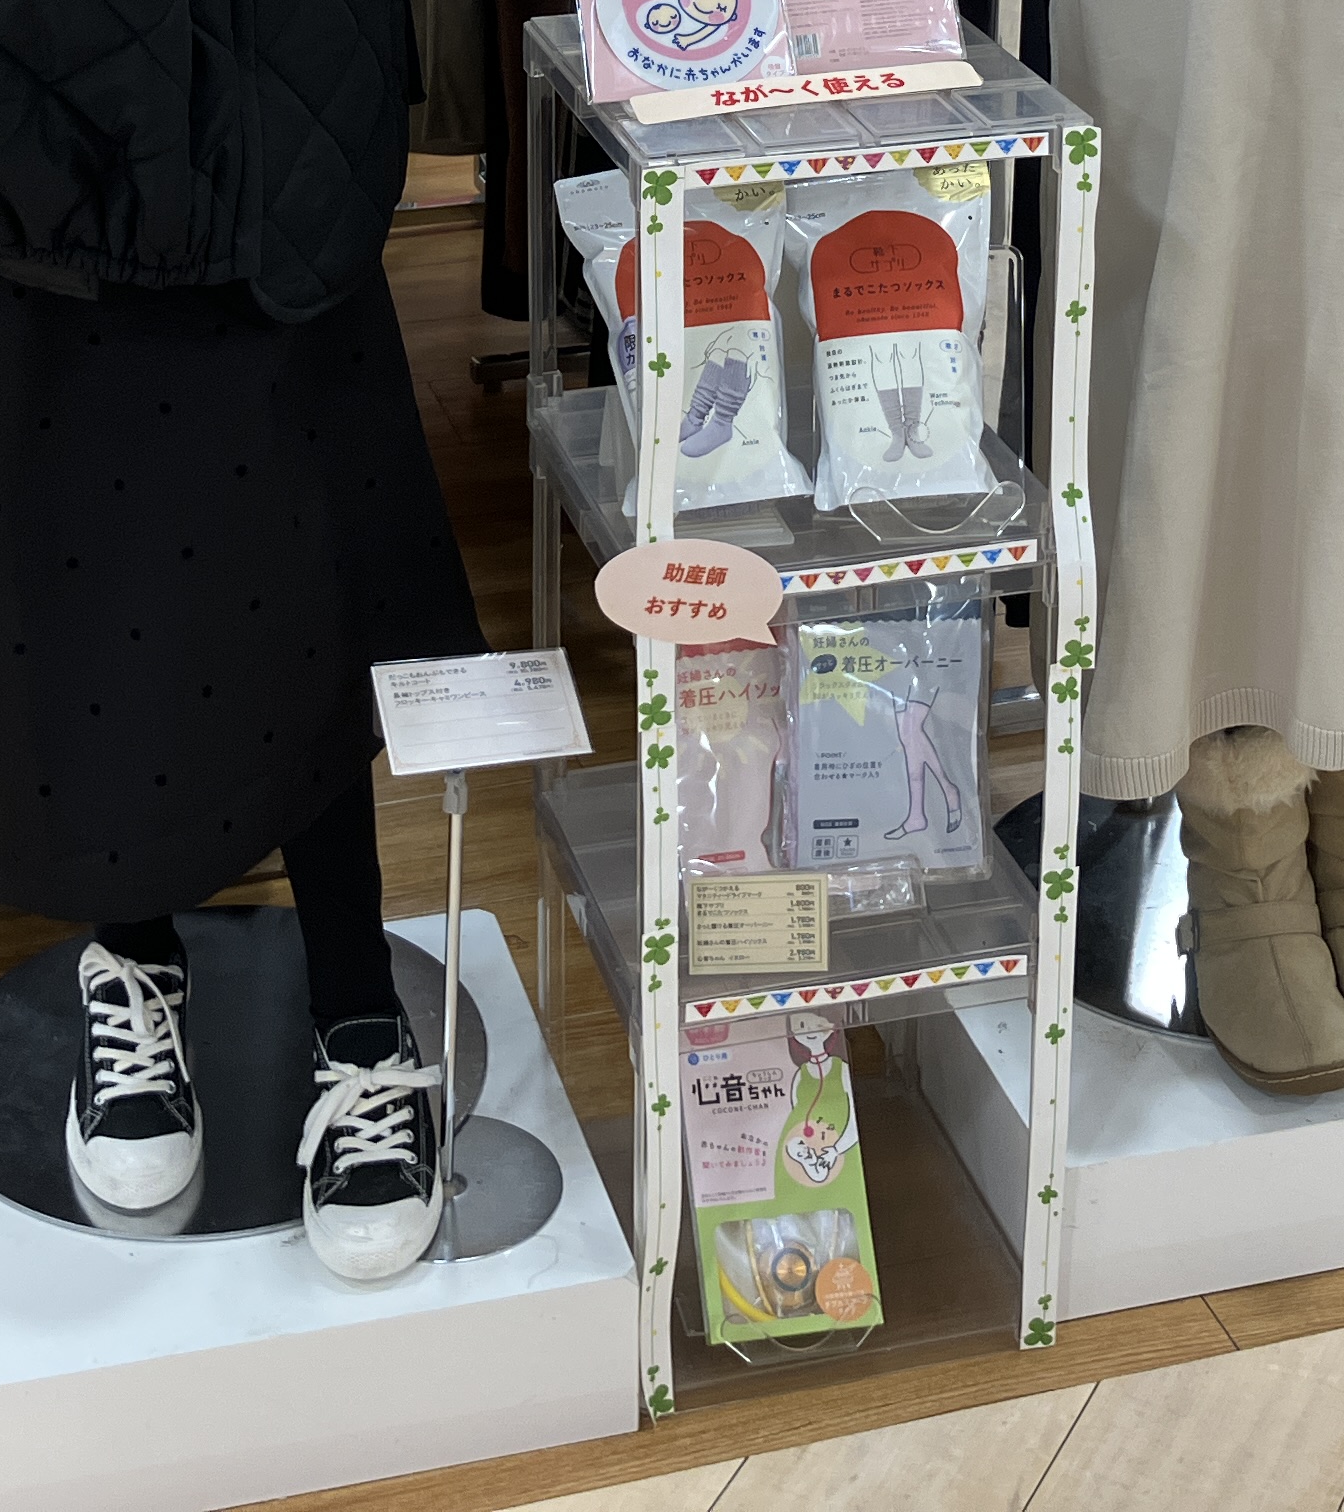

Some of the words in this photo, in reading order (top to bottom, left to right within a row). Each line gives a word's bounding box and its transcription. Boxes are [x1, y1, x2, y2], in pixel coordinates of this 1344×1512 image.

[627, 27, 767, 82] おなかに赤ちゃんがいます
[711, 72, 905, 107] なが〜く使える
[940, 178, 981, 190] かい。
[735, 188, 775, 202] かい。
[832, 280, 946, 298] まるでこたつソックス
[858, 426, 877, 434] Ankle
[663, 563, 728, 588] 助産師
[643, 597, 728, 621] おすすめ
[812, 636, 870, 649] 妊婦さんの
[841, 656, 963, 674] 着圧オーバーニー
[676, 667, 736, 685] 妊婦さんの
[692, 1074, 786, 1106] 心音ちゃん
[712, 1103, 769, 1115] COCONE-CHAN
